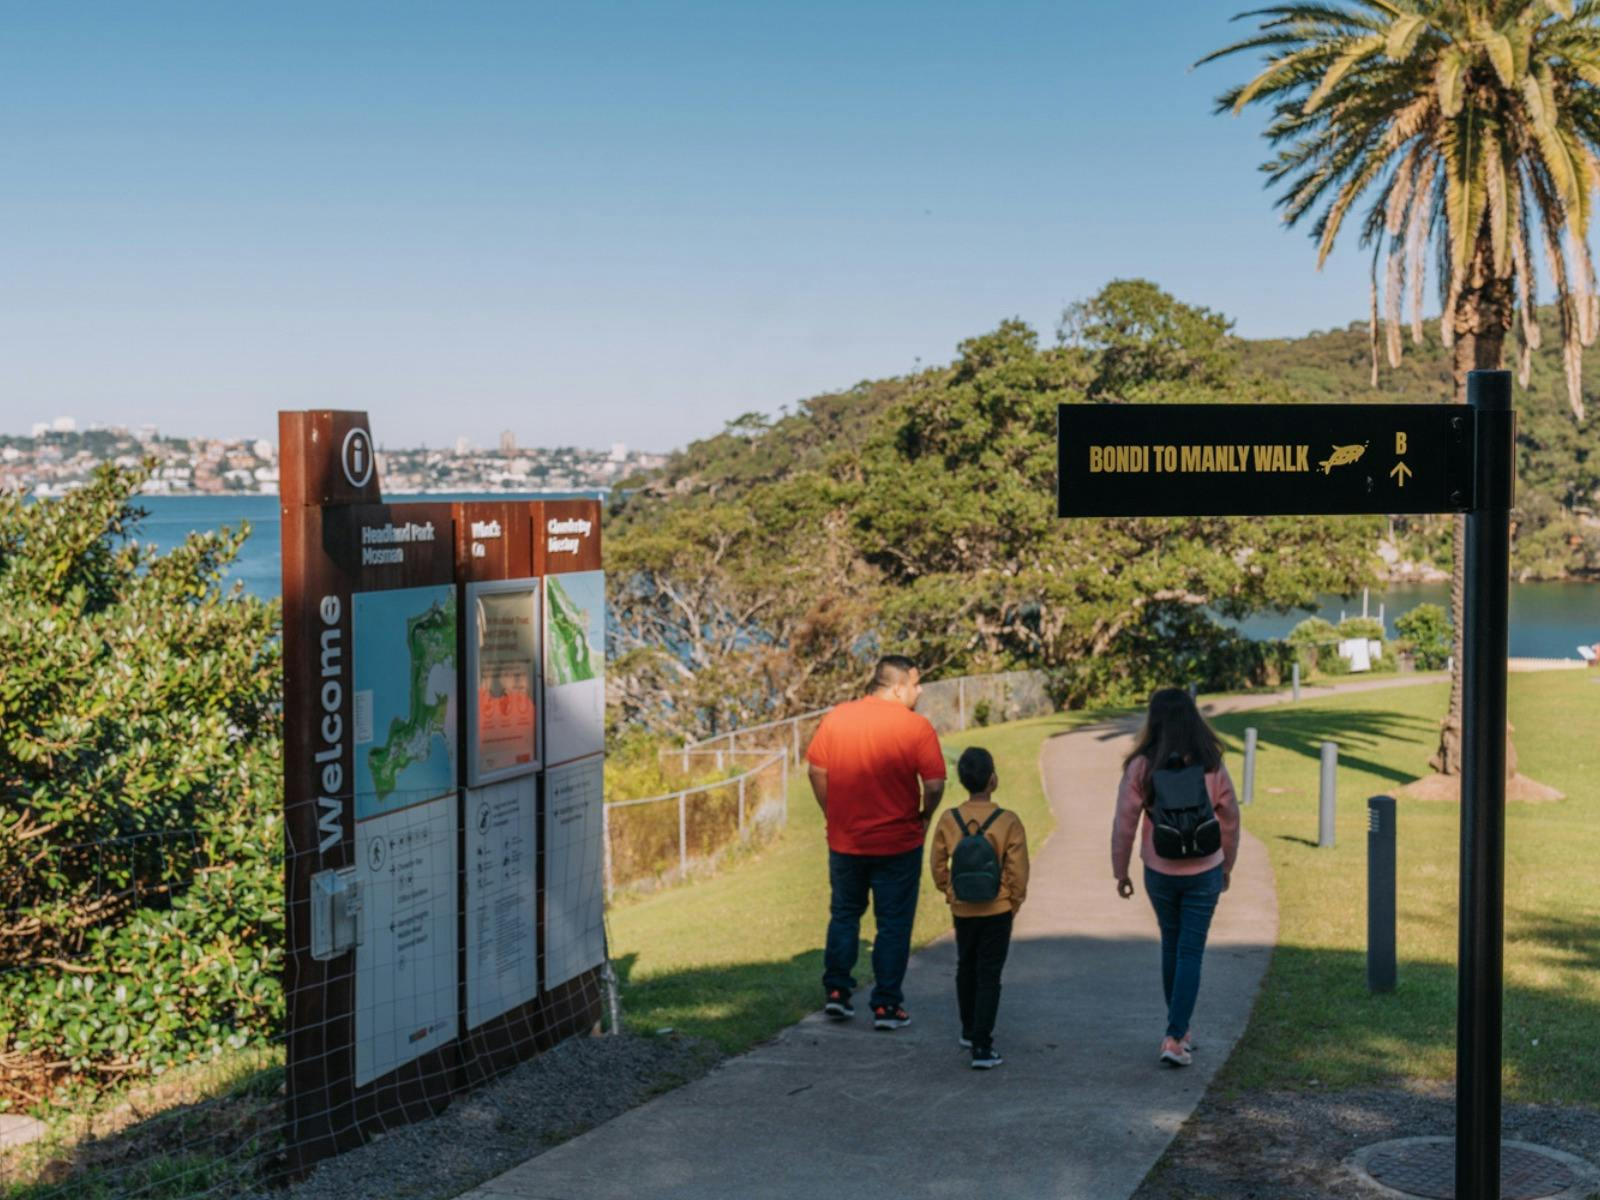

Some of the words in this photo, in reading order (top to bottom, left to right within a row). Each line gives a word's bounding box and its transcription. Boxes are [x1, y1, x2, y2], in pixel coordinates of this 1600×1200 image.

[1395, 431, 1407, 455] B
[1089, 445, 1149, 473] BONDI
[1153, 445, 1178, 473] TO
[1181, 445, 1250, 472] MANLY
[1253, 445, 1310, 472] WALK
[362, 522, 411, 544] Headland
[411, 521, 435, 542] Park
[362, 546, 404, 566] Mosman
[315, 595, 343, 854] Welcome
